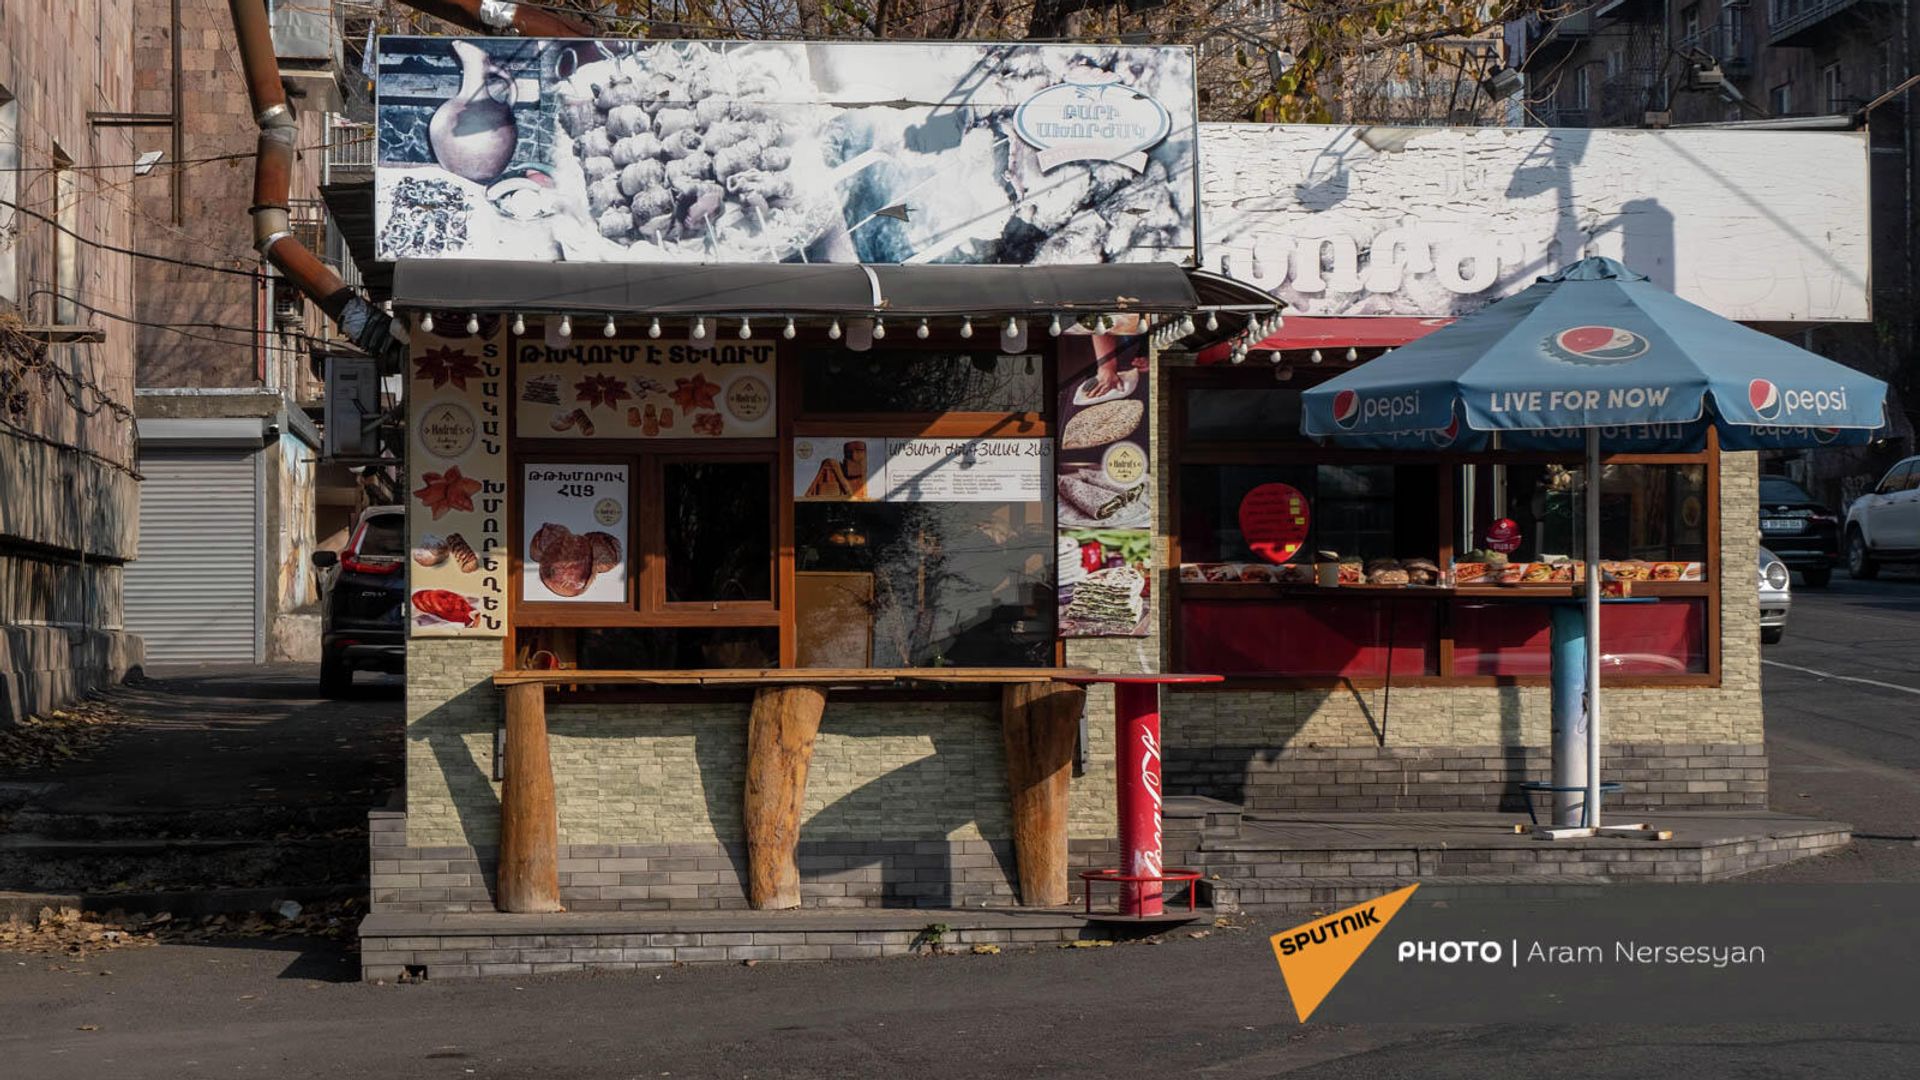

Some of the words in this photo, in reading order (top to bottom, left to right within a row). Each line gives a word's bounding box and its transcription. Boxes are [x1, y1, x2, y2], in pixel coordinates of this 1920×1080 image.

[518, 345, 640, 366] ԹԽՎՈՒՄ
[646, 345, 663, 366] Է
[669, 345, 774, 366] ՏԵՂՈՒՄ
[482, 343, 501, 455] ՏՆԱԿԱՆ
[1364, 390, 1420, 424] pepsi
[1490, 391, 1542, 412] LIVE
[1549, 390, 1601, 411] FOR
[1608, 387, 1670, 409] NOW
[1785, 386, 1847, 416] pepsi
[528, 471, 625, 483] ԹԹԽՄՈՐՈՎ
[557, 484, 595, 498] ՀԱՑ
[482, 479, 505, 631] ԽՄՈՐԵՂԵՆ
